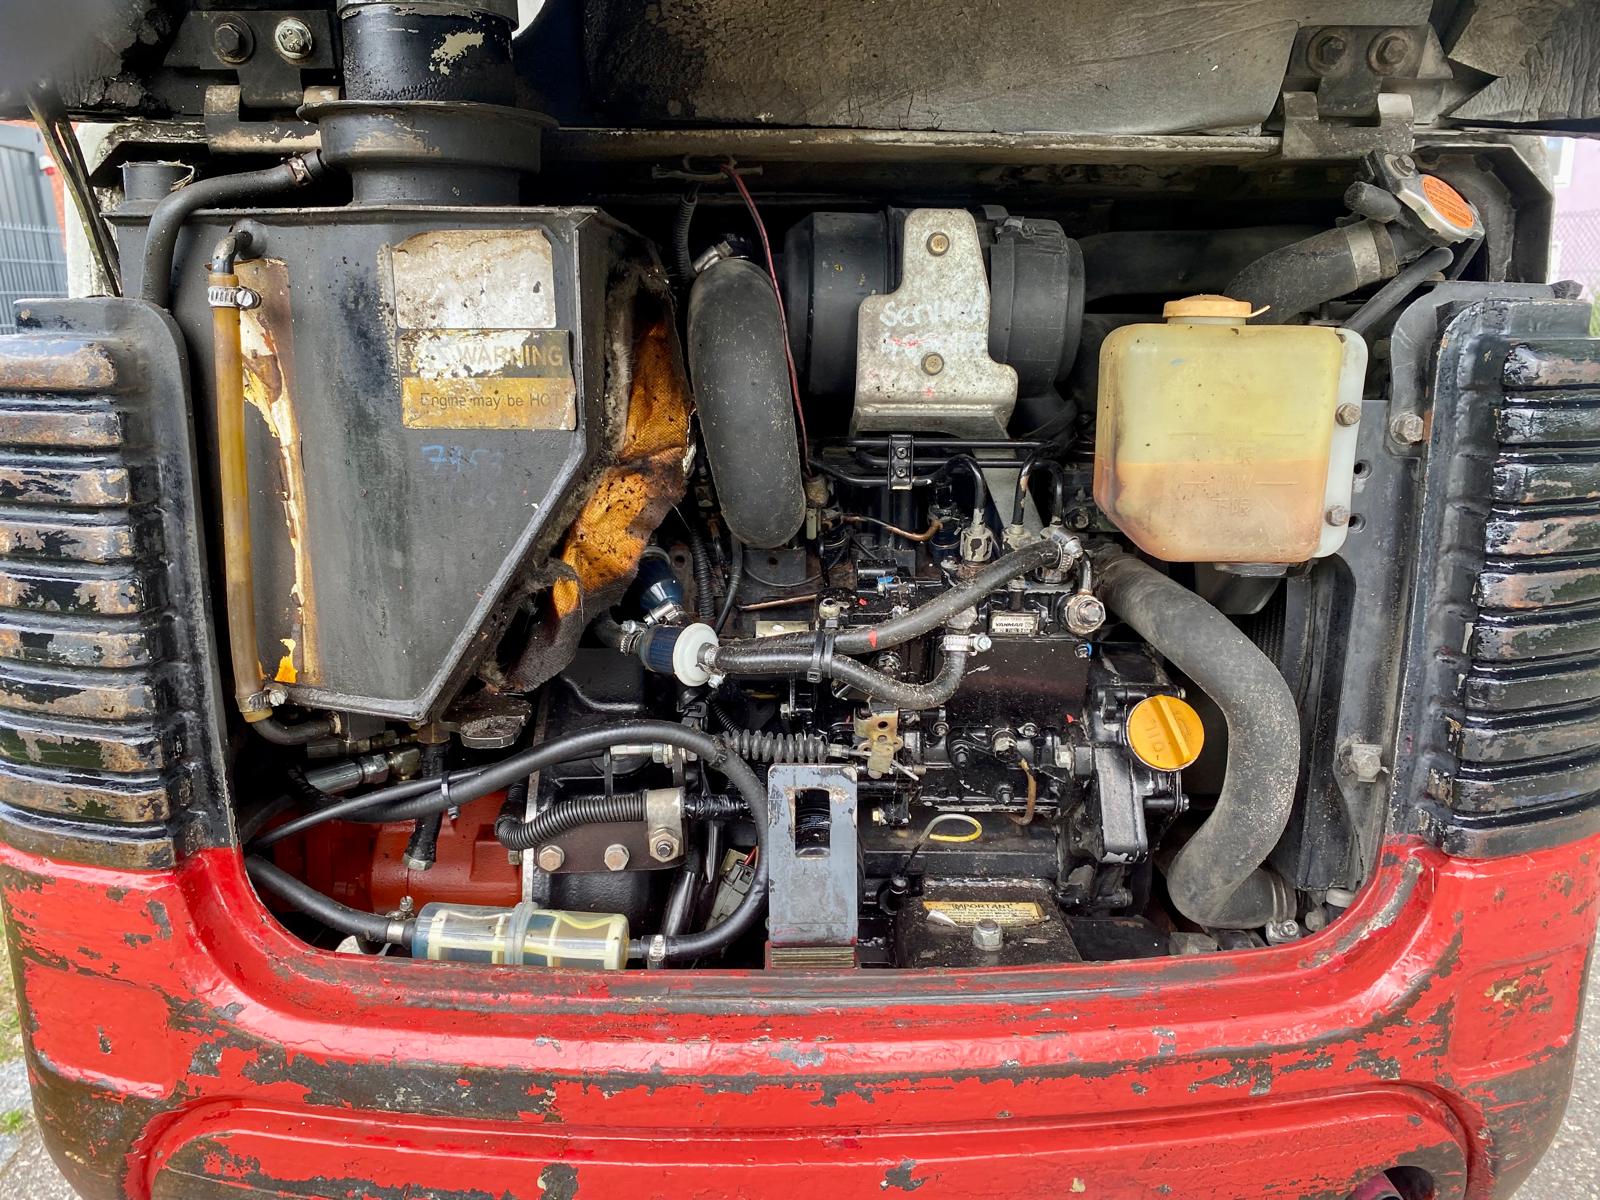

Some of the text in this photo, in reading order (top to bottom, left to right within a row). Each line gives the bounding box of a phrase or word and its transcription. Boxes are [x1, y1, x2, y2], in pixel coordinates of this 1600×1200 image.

[456, 344, 563, 367] WARNING
[420, 392, 559, 409] Engine may be HOT
